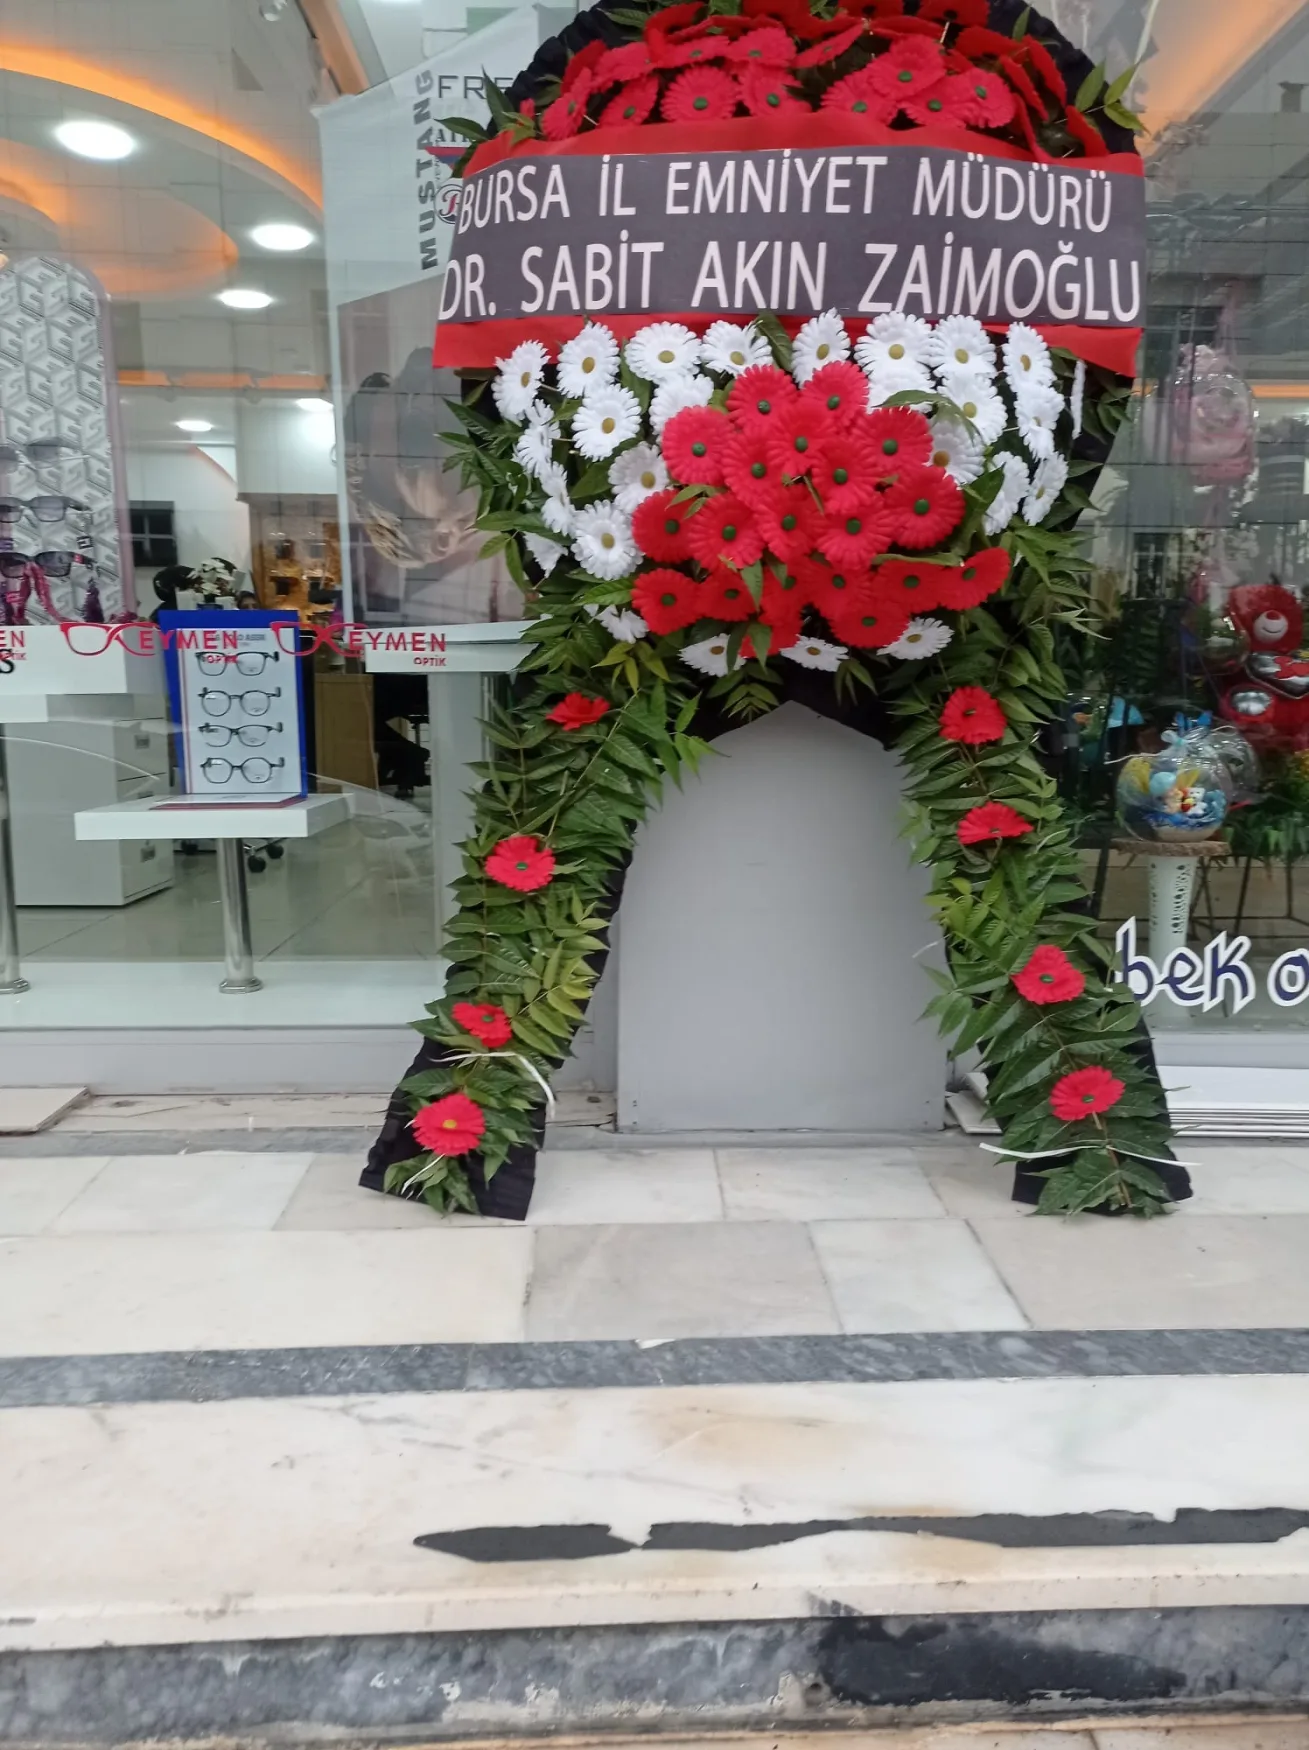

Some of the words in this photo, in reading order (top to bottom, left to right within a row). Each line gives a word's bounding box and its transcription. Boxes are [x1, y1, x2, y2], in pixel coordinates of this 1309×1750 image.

[413, 70, 438, 270] MUSTANG
[458, 165, 570, 234] BURSA
[599, 154, 636, 216] İL
[666, 149, 888, 215] EMNİYET
[912, 152, 1112, 233] MÜDÜRÜ
[438, 253, 497, 320] DR.
[520, 229, 664, 313] SABİT
[691, 241, 827, 310] AKIN
[857, 231, 1140, 322] ZAİMOĞLU
[139, 630, 238, 650] EYMEN
[348, 631, 446, 652] EYMEN
[413, 655, 447, 667] OPTİK
